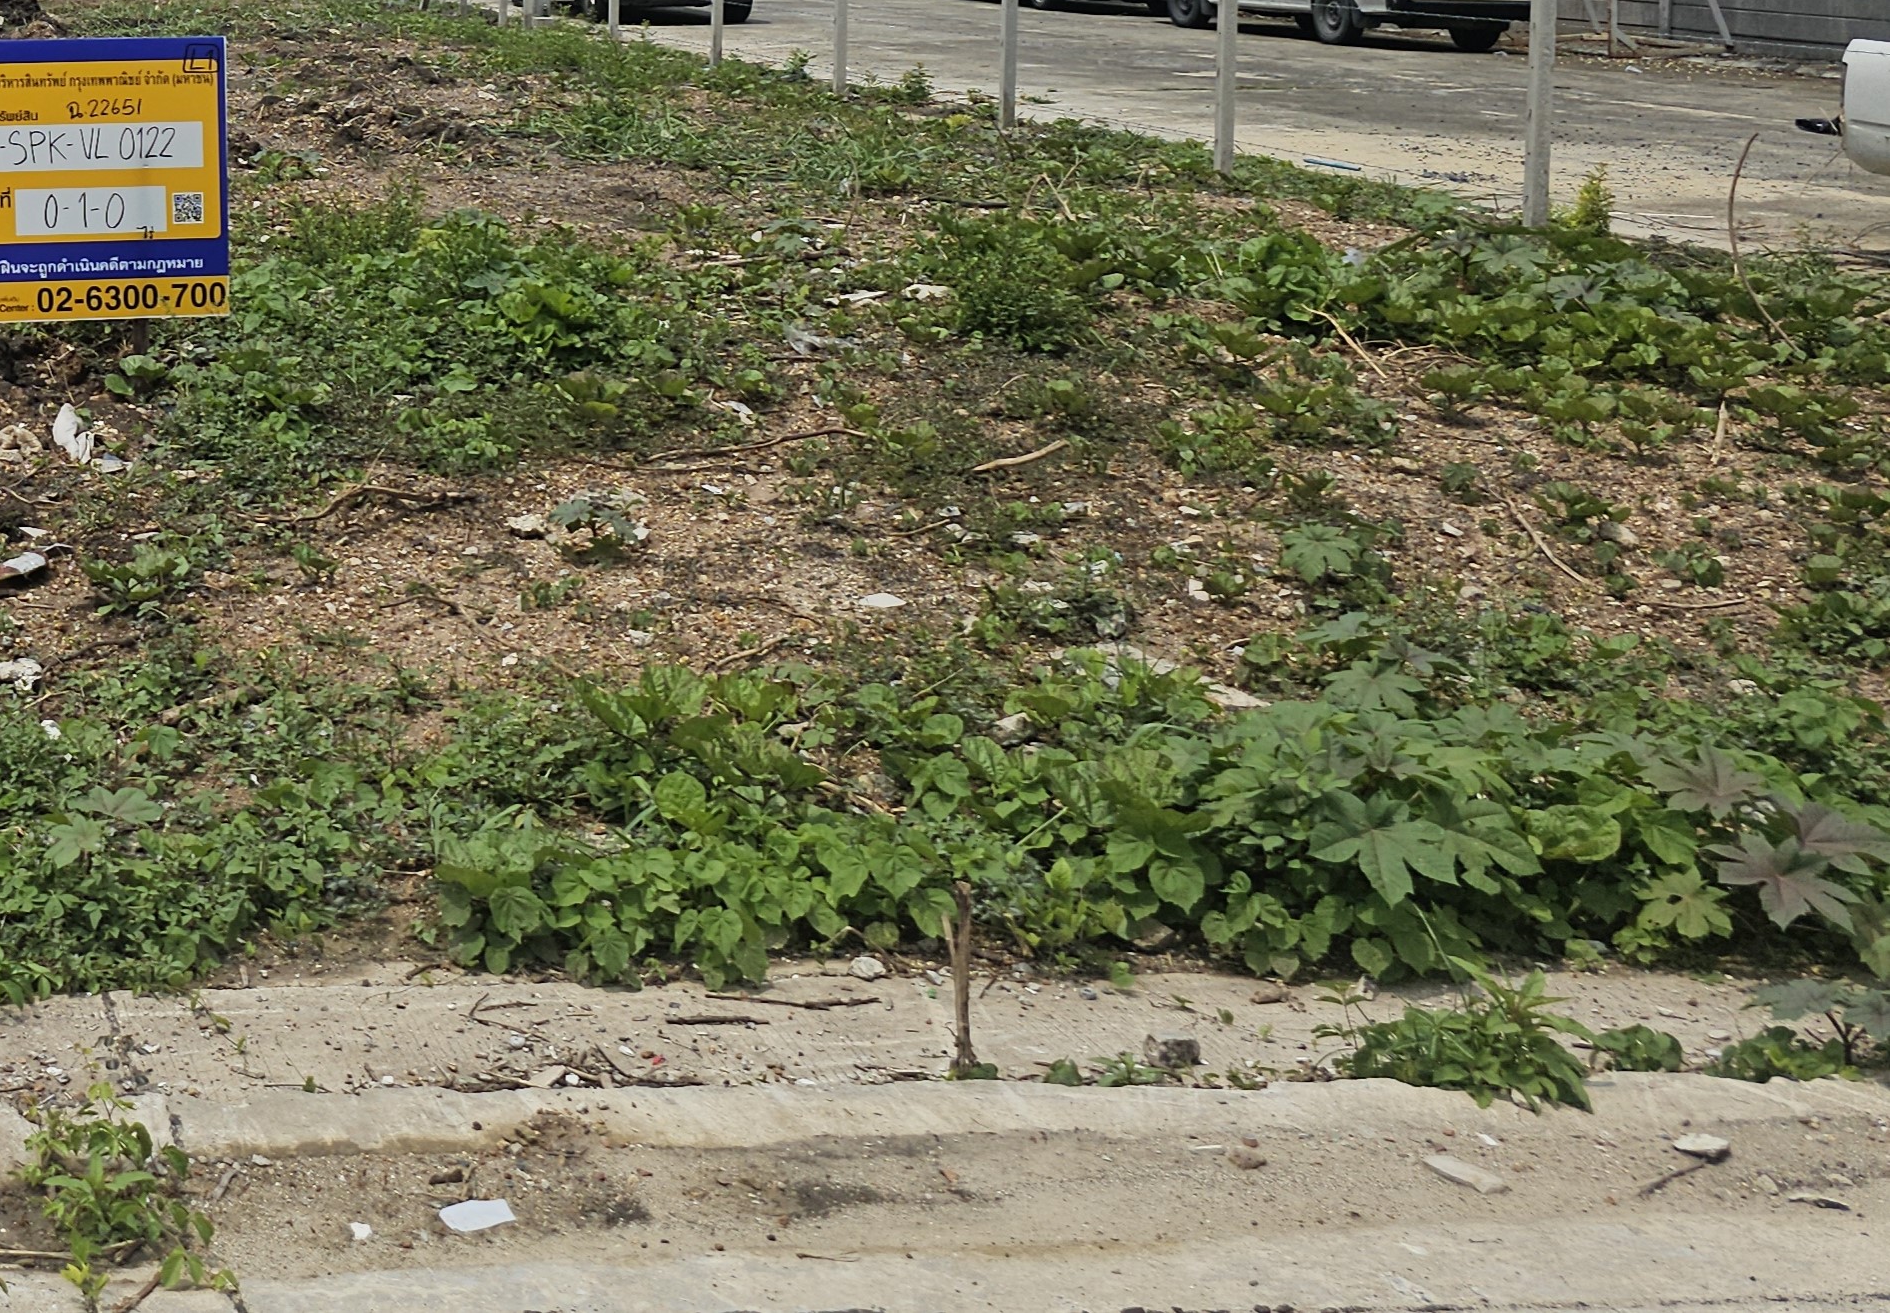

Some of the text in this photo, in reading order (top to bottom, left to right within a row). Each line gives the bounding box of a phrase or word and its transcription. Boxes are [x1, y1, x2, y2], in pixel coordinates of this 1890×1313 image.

[144, 69, 170, 86] จำกัด
[44, 192, 125, 229] 0-1-0
[37, 282, 227, 313] 02-6300-700
